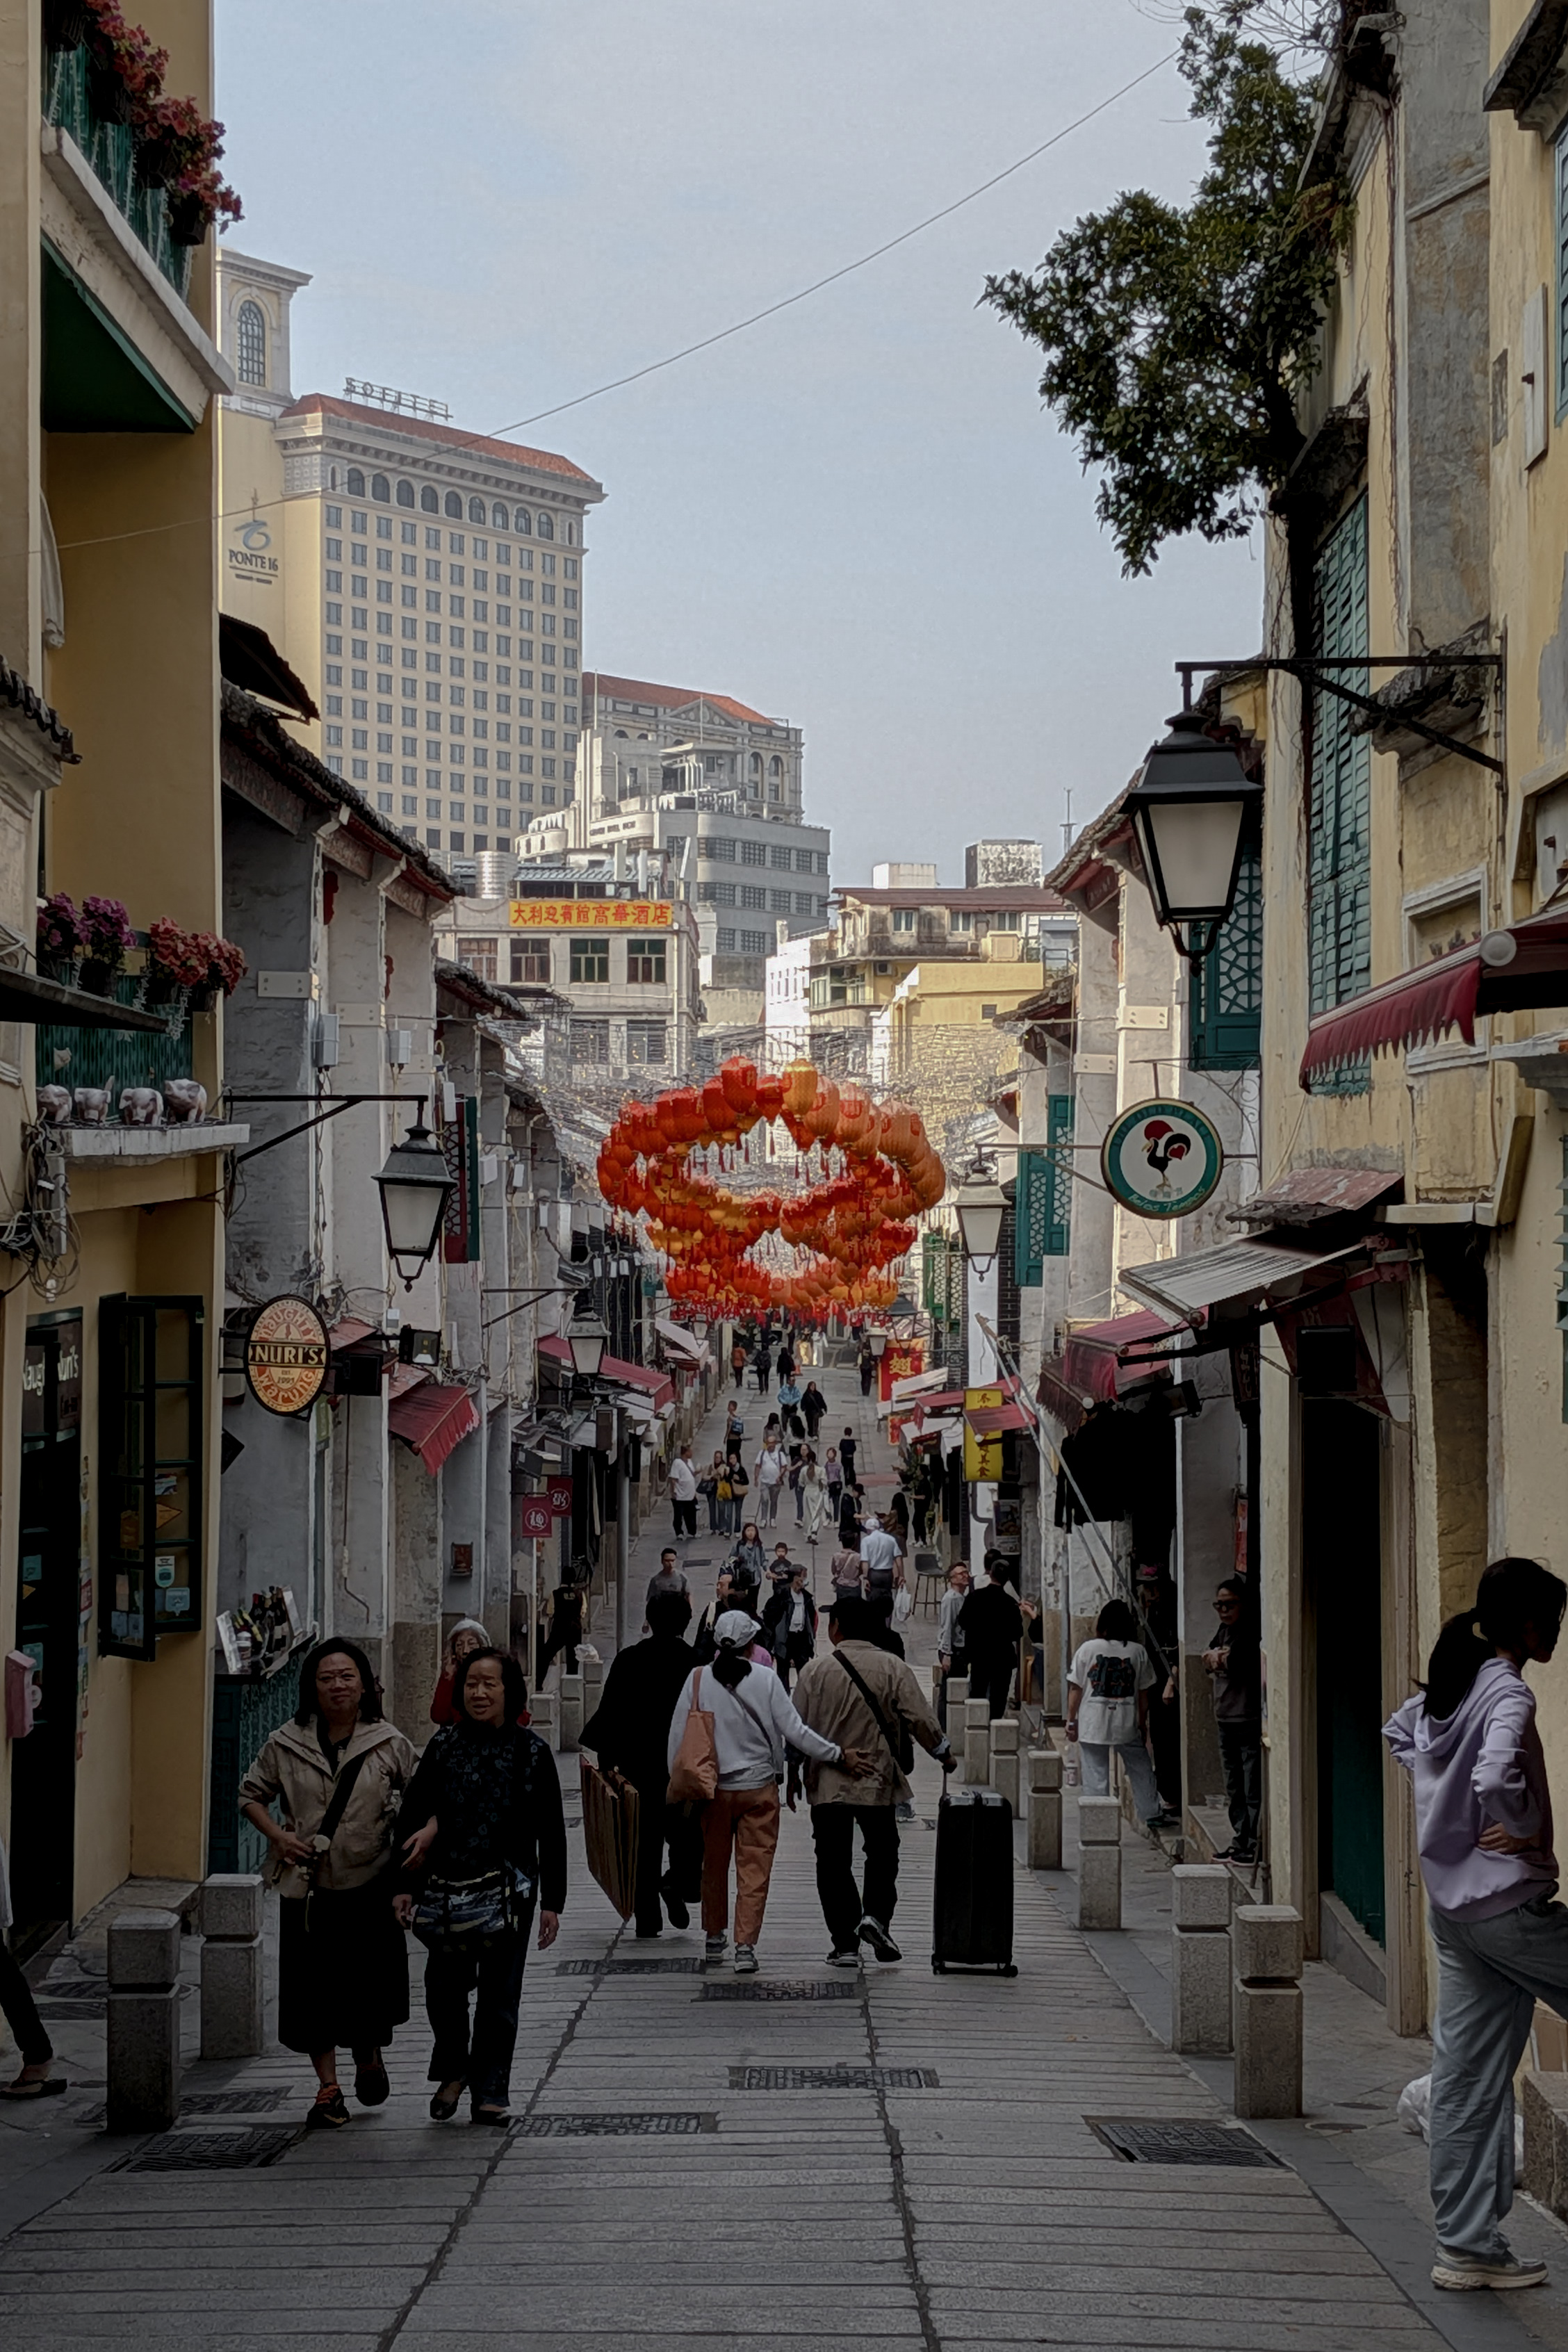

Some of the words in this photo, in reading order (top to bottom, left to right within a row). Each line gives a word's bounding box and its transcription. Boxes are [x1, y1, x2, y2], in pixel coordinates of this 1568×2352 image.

[229, 549, 266, 569] PONTE
[268, 557, 279, 571] 16
[255, 1345, 318, 1365] NURI'S
